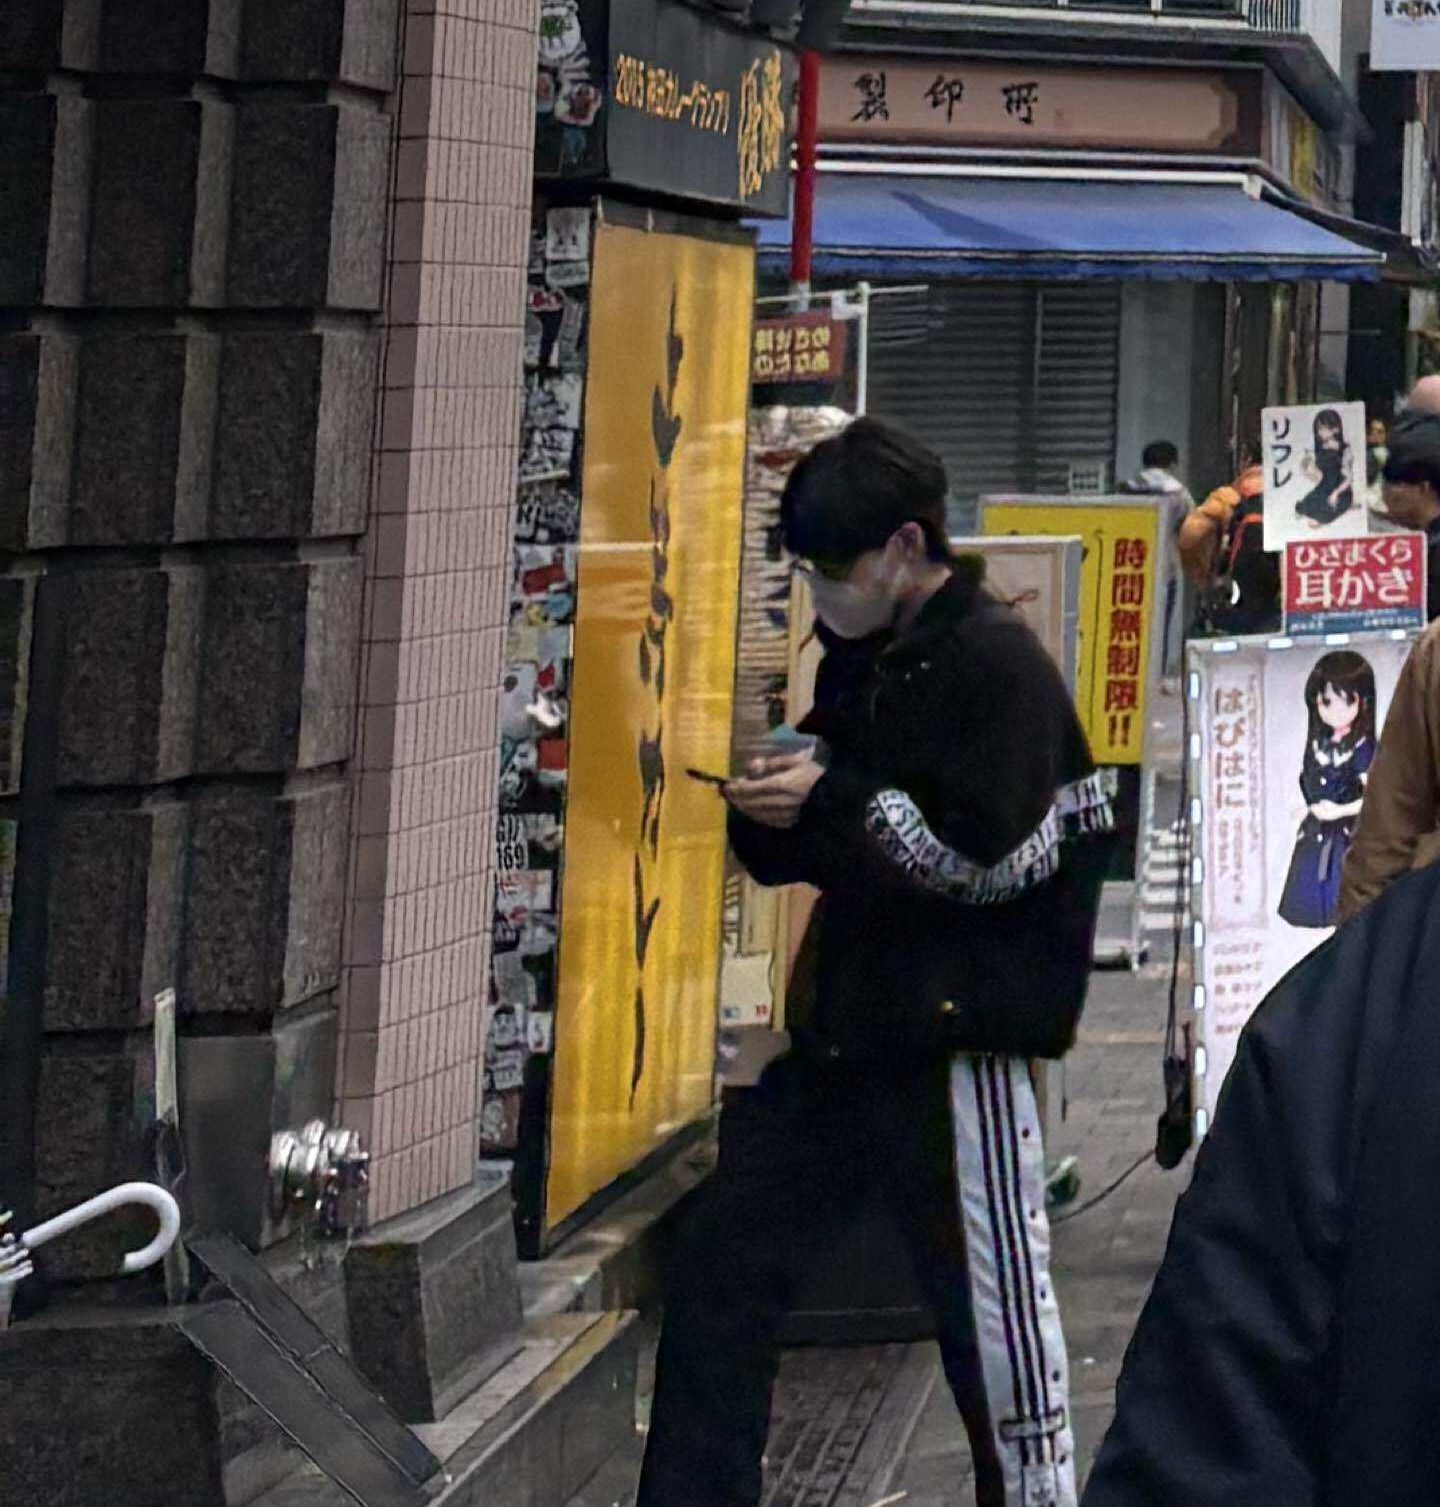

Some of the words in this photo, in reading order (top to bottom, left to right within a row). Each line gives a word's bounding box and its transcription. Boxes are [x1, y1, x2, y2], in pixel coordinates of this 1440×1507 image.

[1272, 417, 1292, 488] リフレ
[1295, 539, 1412, 568] ひざまくら
[1296, 567, 1413, 608] 耳かき
